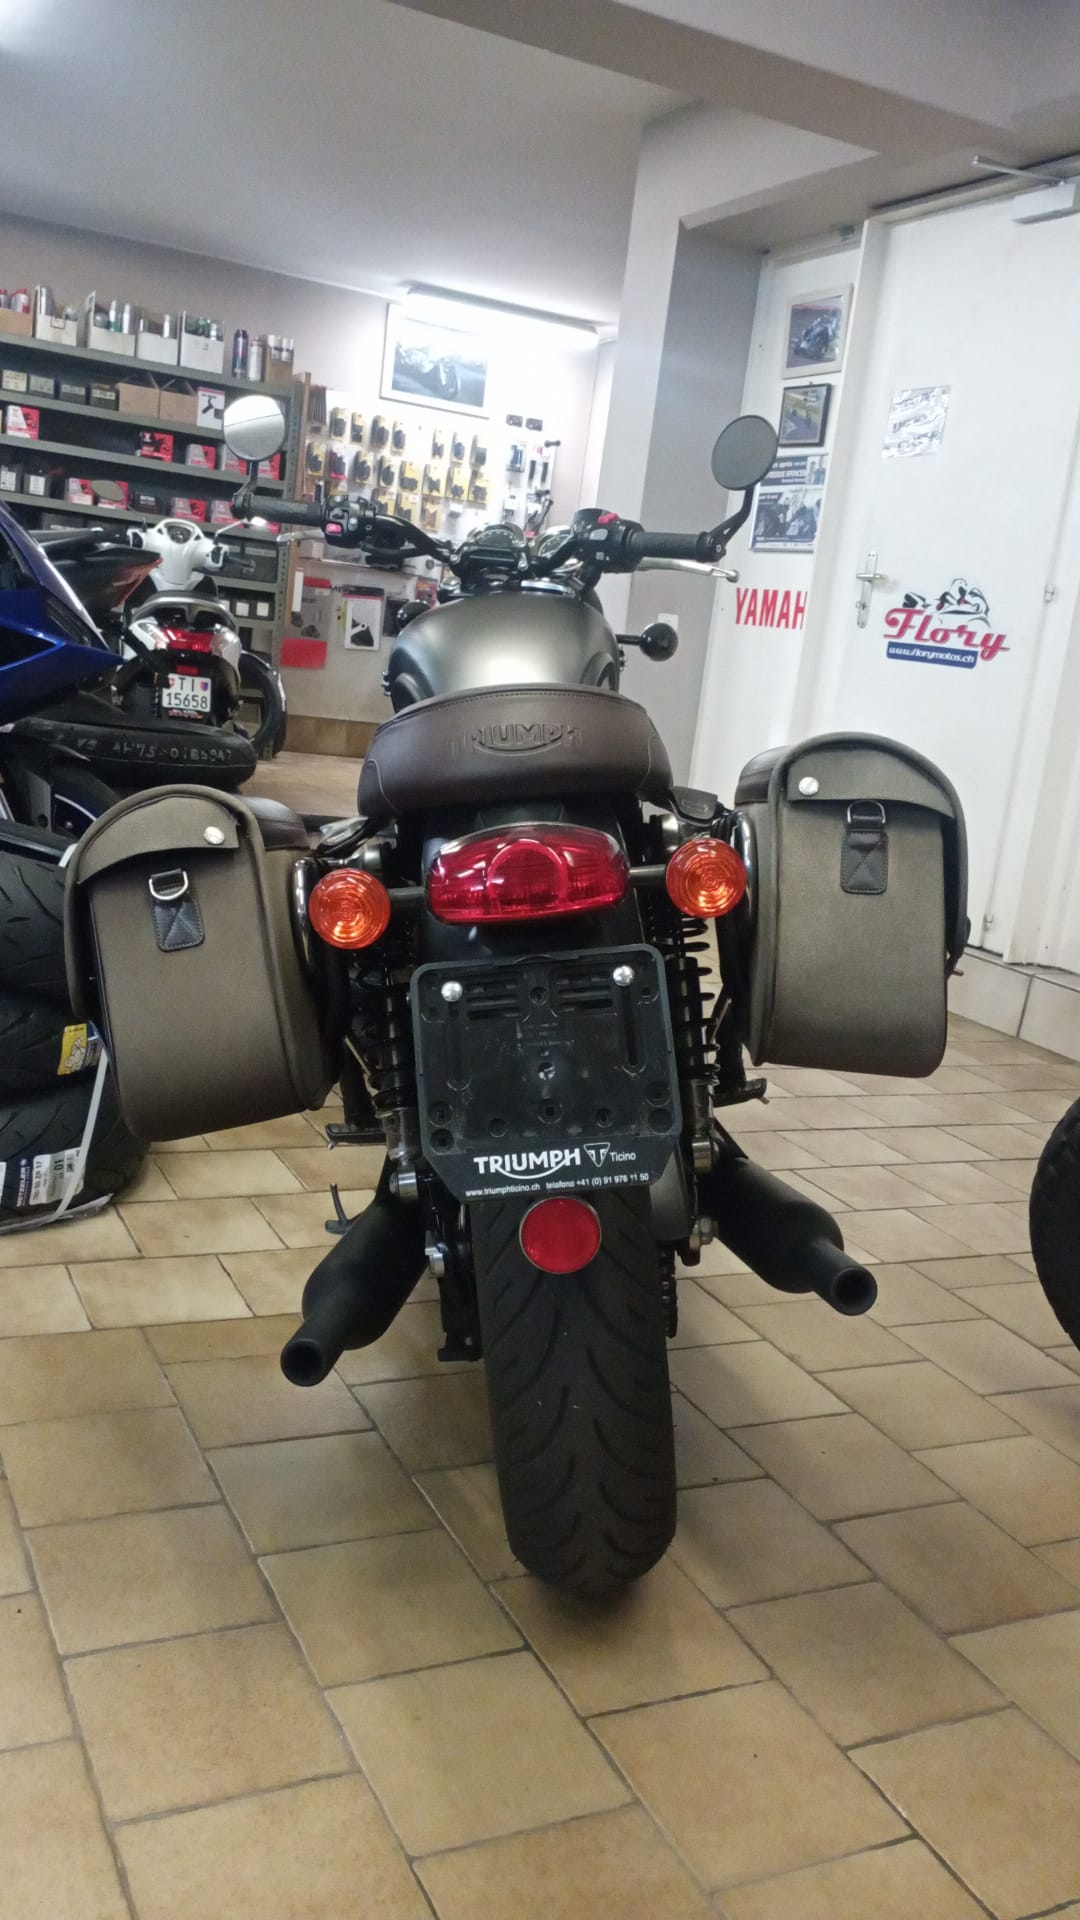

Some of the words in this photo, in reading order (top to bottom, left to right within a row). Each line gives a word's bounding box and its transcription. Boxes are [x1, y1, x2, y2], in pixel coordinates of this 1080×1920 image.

[883, 607, 1010, 661] Flory
[888, 646, 976, 664] www.florymotos.ch
[166, 692, 208, 710] 15658
[473, 1148, 581, 1180] TRIUMPH
[609, 1151, 637, 1162] Ticino
[465, 1182, 541, 1198] www.triumphticino.ch
[545, 1179, 575, 1190] telefono
[576, 1178, 590, 1187] +41
[591, 1177, 602, 1187] (0)
[603, 1176, 612, 1185] 91
[630, 1172, 638, 1182] 11
[639, 1172, 649, 1182] 50
